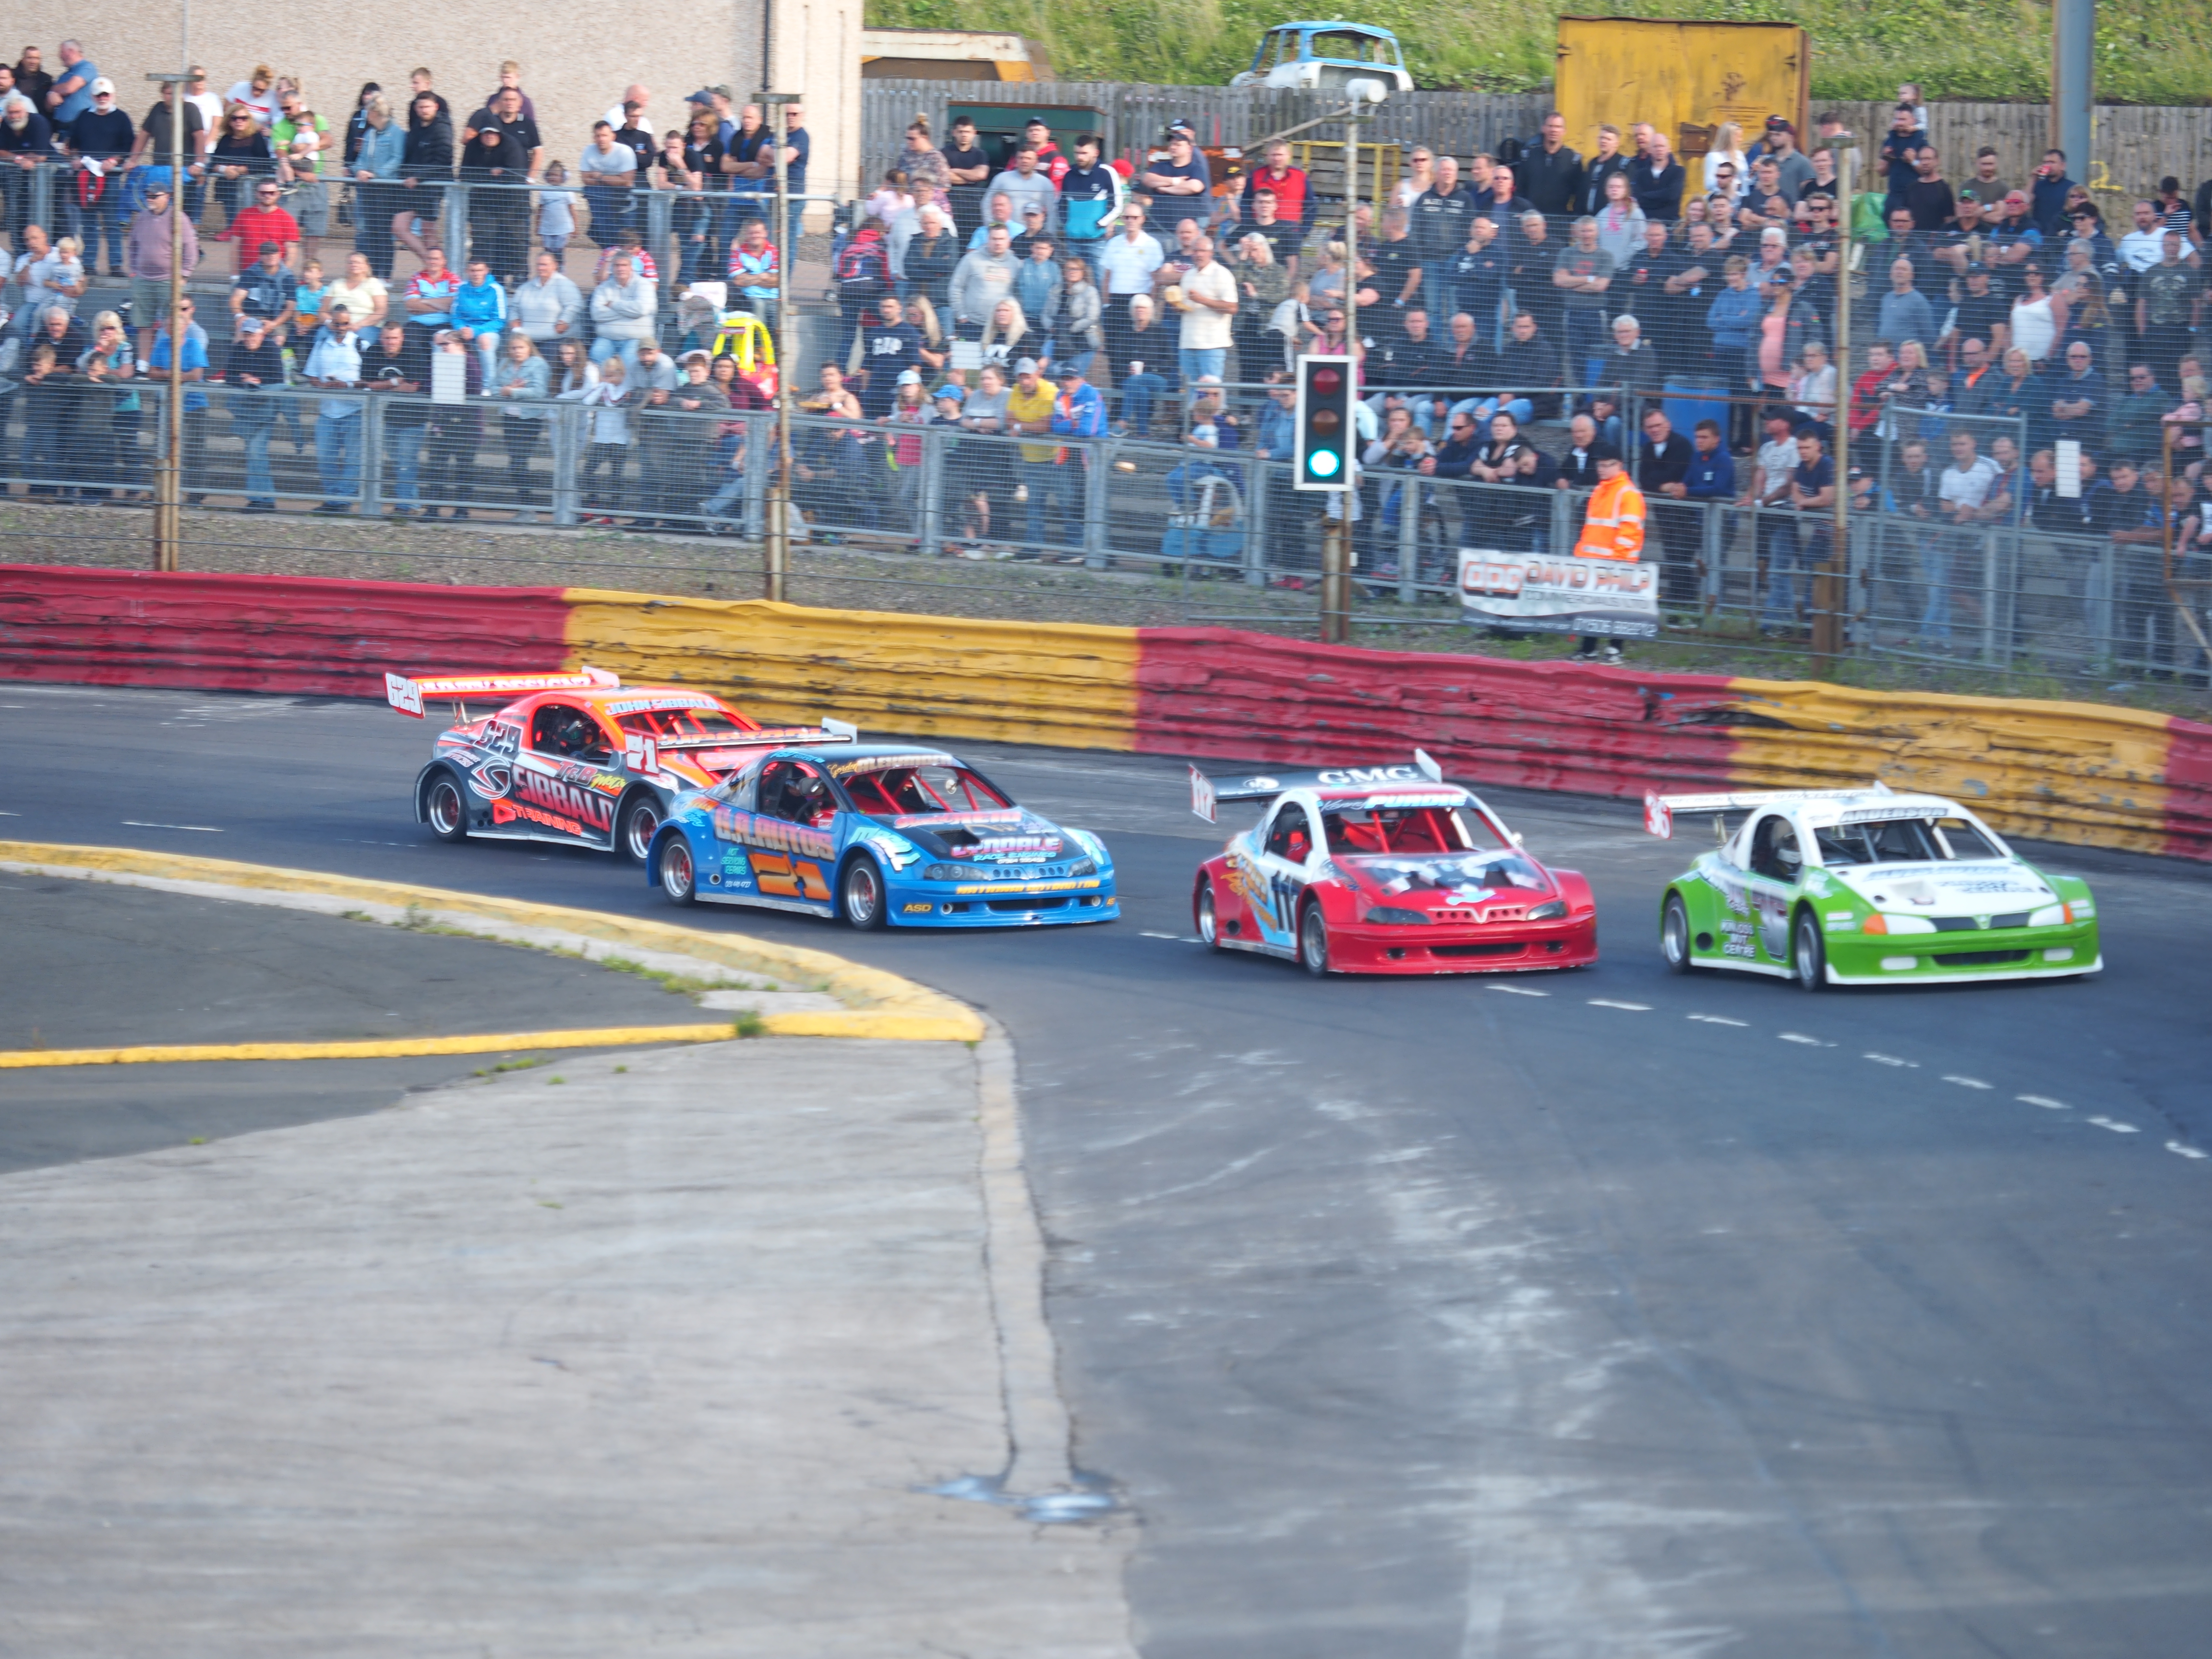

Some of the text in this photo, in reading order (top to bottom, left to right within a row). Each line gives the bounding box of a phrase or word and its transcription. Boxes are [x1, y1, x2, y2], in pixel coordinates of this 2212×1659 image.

[1465, 559, 1522, 595] dpc
[1527, 560, 1587, 588] DAVID
[386, 673, 421, 714] 629
[605, 698, 720, 716] JOHN SIBBALD
[1319, 766, 1419, 784] GMG
[512, 765, 614, 832] SIBBALD
[1364, 793, 1469, 809] PURDIE
[1773, 792, 1830, 800] SERVICES
[512, 804, 582, 836] TRAINING
[1645, 795, 1671, 839] 36
[1839, 806, 1949, 823] ANDERSON
[951, 836, 1061, 857] LYNDALE
[973, 852, 1006, 863] RACE
[903, 903, 932, 913] ASD
